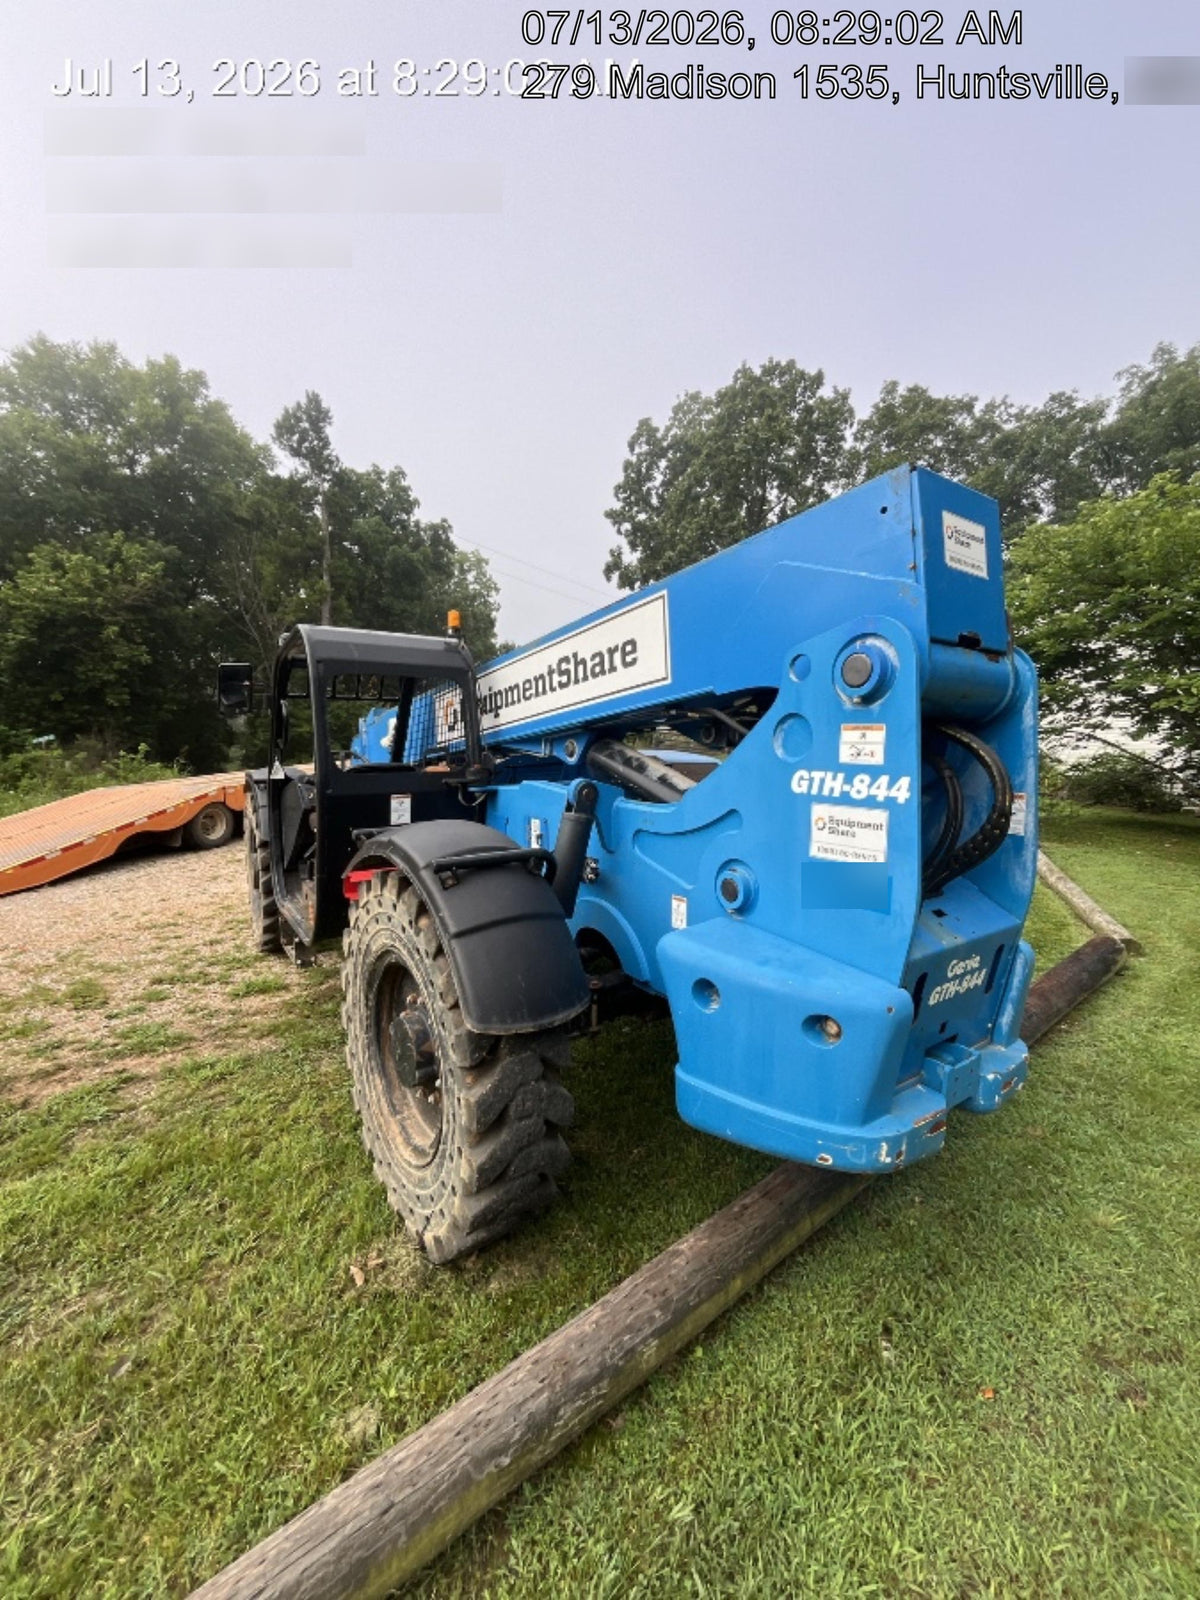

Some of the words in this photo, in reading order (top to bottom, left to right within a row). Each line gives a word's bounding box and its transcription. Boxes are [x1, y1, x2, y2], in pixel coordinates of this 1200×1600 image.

[790, 769, 912, 805] GTH-844
[828, 815, 884, 831] Equipment
[928, 968, 987, 1007] GTH-844
